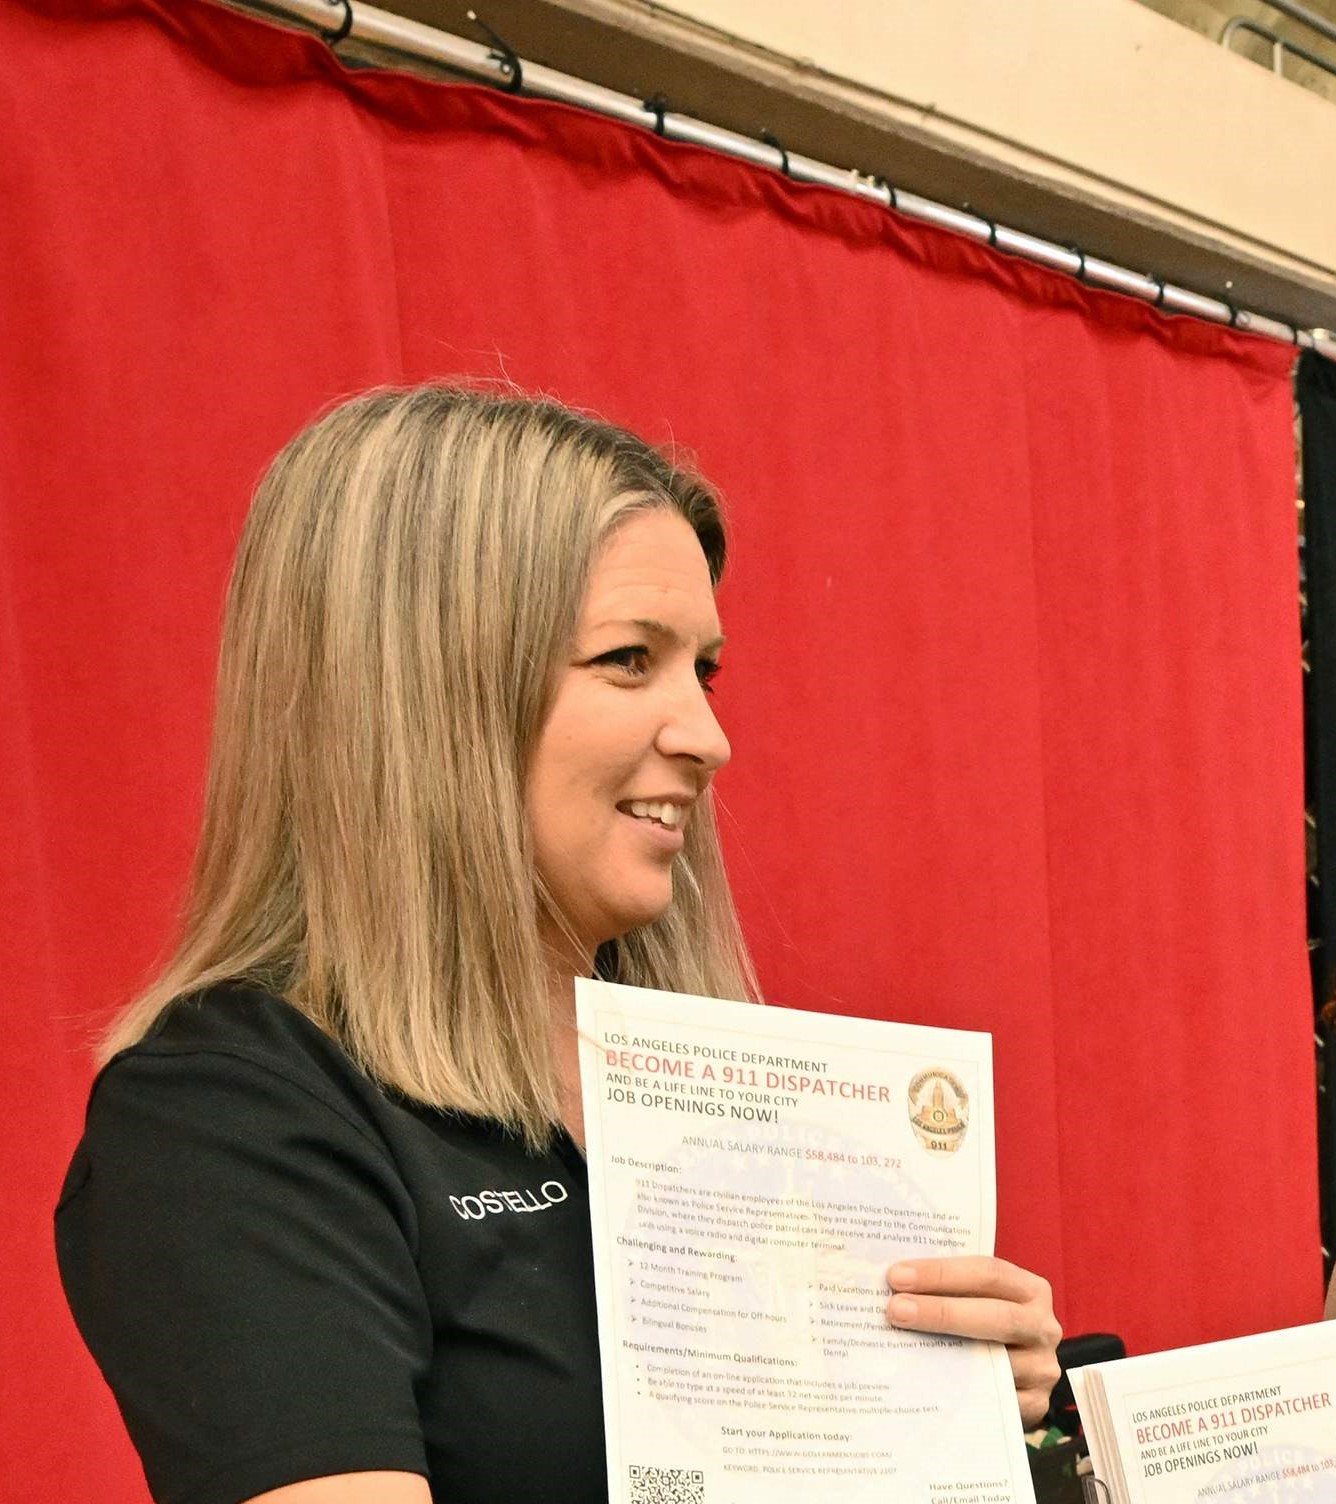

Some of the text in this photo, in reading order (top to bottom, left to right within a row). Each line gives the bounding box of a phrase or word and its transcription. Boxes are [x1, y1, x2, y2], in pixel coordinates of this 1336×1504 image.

[604, 1032, 827, 1073] LOS ANGELES POLICE DEPARTMENT
[606, 1050, 890, 1103] BECOME A 911 DISPATCHER
[606, 1073, 798, 1108] AND BE A LIFE LINE TO YOUR CITY
[607, 1088, 778, 1124] JOB OPENINGS NOW!
[682, 1136, 901, 1169] ANNUAL SALARY RANGE $58,484 to 103, 272
[931, 1140, 947, 1150] 911
[611, 1156, 679, 1174] Job Description:
[449, 1181, 568, 1220] COSTELLO
[616, 1236, 736, 1263] Challenging and Rewarding:
[651, 1263, 676, 1274] Month
[677, 1267, 708, 1279] Training
[710, 1272, 743, 1282] Program
[640, 1280, 710, 1298] Competitive Salary
[641, 1298, 680, 1310] Additional
[681, 1303, 736, 1318] Compensation
[738, 1310, 748, 1319] for
[642, 1317, 707, 1333] Bilingual Bonuses
[623, 1340, 795, 1366] Requirements/Minimum Qualifications:
[1132, 1386, 1281, 1424] LOS ANGELES POLICE DEPARTMENT
[1136, 1392, 1332, 1444] BECOME A 911 DISPATCHER
[721, 1426, 850, 1442] Start your Application today:
[1141, 1425, 1268, 1460] AND BE A LIFE LINE TO YOUR CITY
[1144, 1441, 1258, 1478] JOB OPENINGS NOW!
[956, 1480, 1008, 1490] Questions?
[1198, 1484, 1227, 1497] ANNUAL
[1228, 1477, 1254, 1491] SALARY
[1256, 1471, 1280, 1484] RANGE
[982, 1495, 1011, 1503] Today
